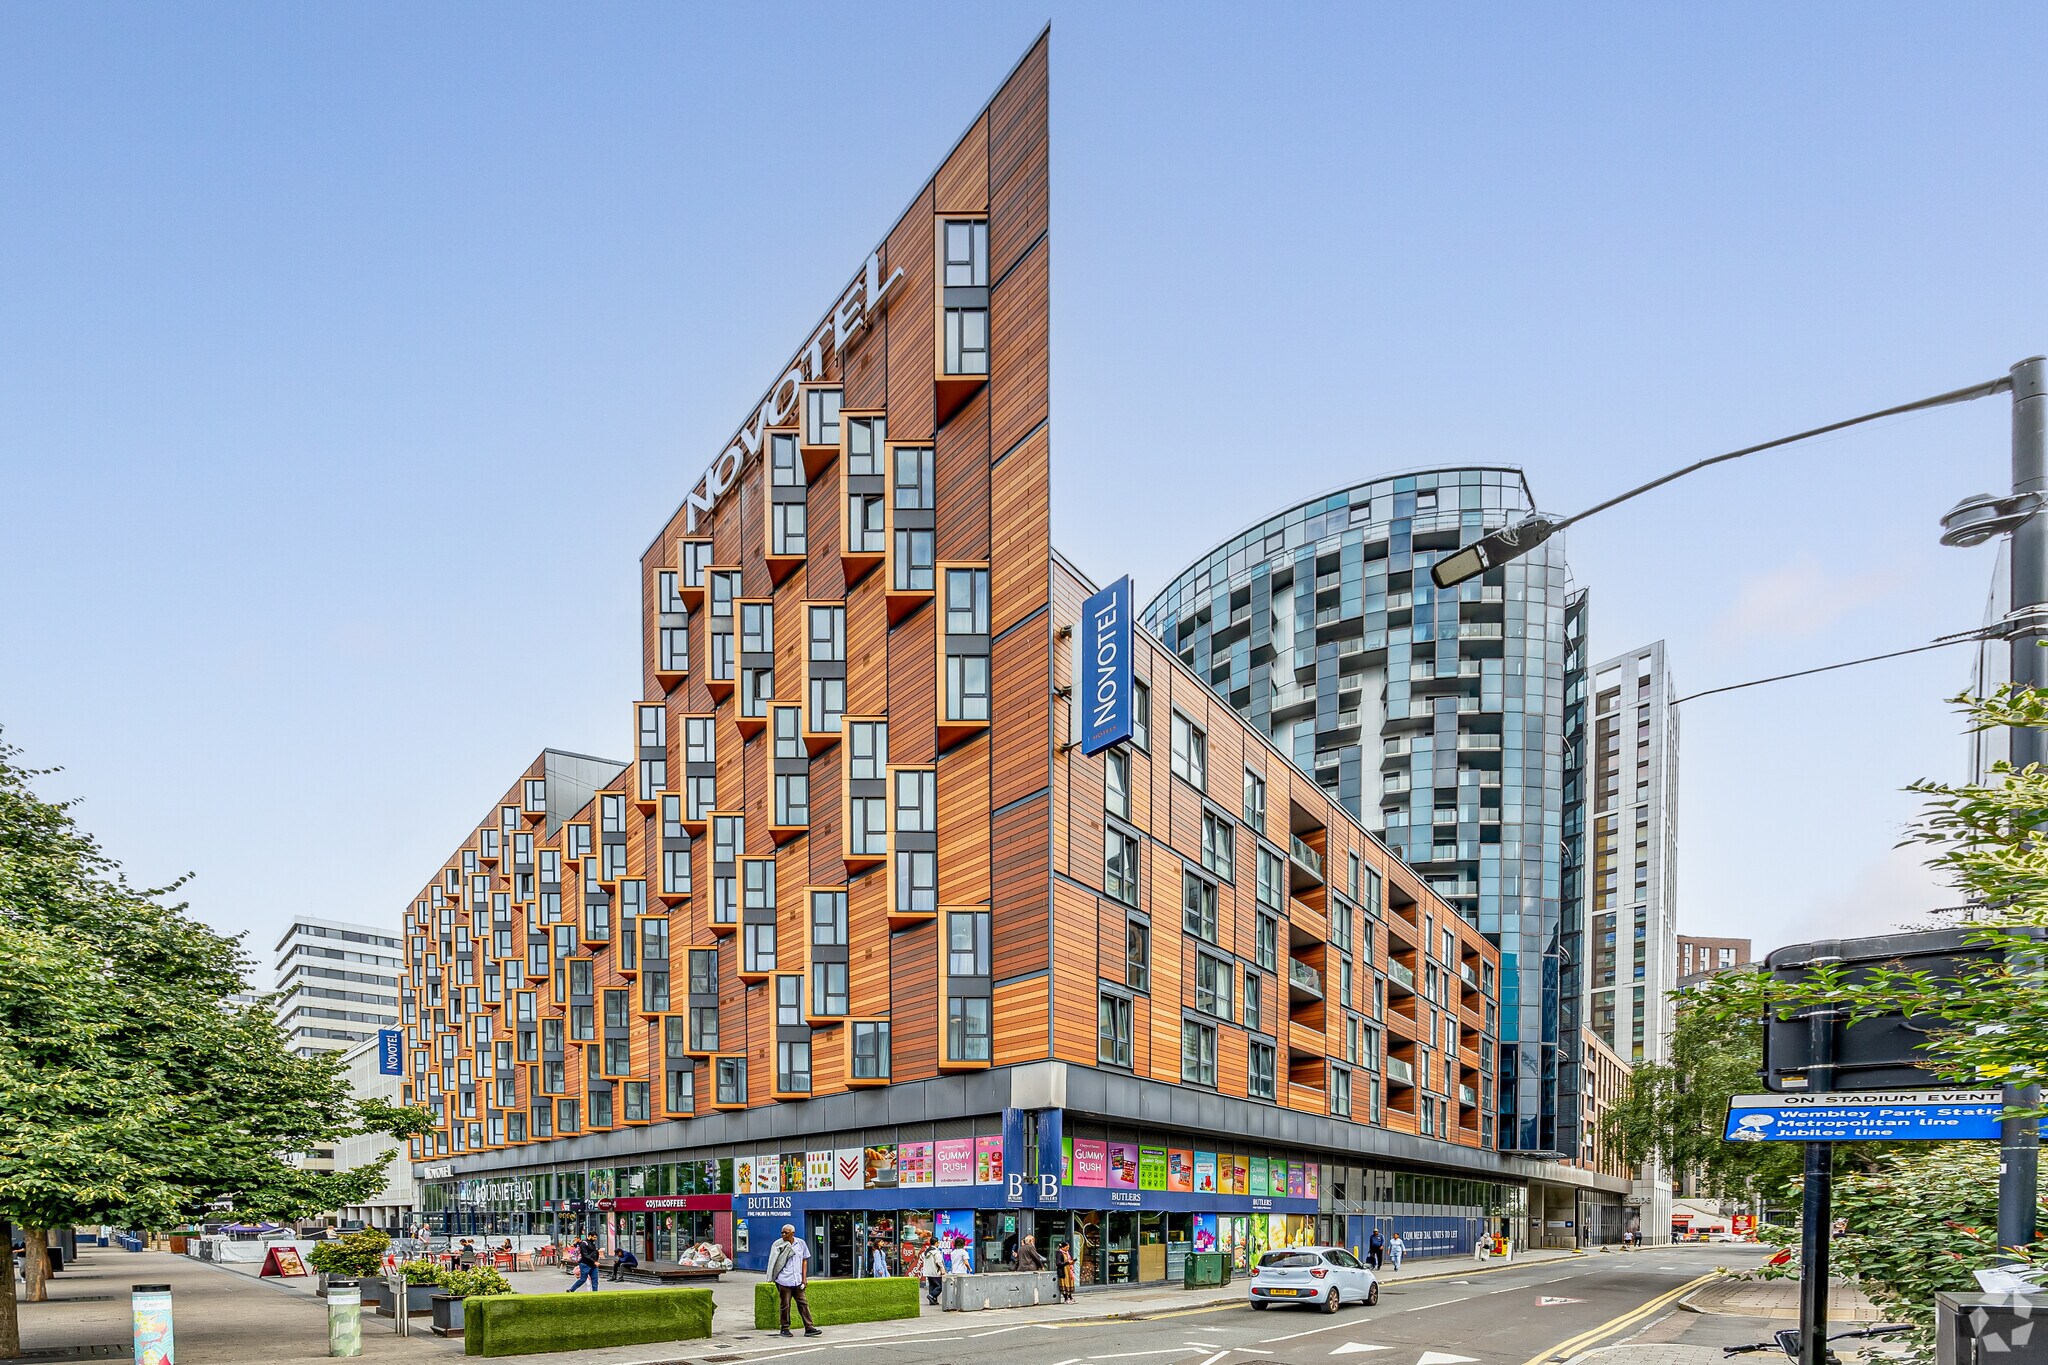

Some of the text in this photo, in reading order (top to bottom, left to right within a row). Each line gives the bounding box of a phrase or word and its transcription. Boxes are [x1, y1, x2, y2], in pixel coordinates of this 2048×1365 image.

[686, 252, 904, 533] NOVOTEL
[1093, 591, 1118, 729] NOVOTEL
[385, 1033, 398, 1070] NOVOTEL
[1784, 1093, 2000, 1104] ON STADIUM EVENT
[1780, 1108, 2003, 1118] Wembley Park Statio
[1776, 1119, 1910, 1127] Metropolitan
[1775, 1129, 1846, 1137] Jubilee
[937, 1151, 971, 1161] GUMMY
[1074, 1148, 1105, 1161] GUMMY
[942, 1162, 967, 1174] RUSH
[1079, 1161, 1102, 1173] RUSH
[1007, 1173, 1023, 1197] B
[1039, 1174, 1058, 1197] B
[748, 1196, 792, 1209] BUTLERS
[1111, 1192, 1141, 1202] BUTLERS
[1252, 1198, 1272, 1206] BUTLERS
[645, 1199, 687, 1209] COSTA COFFEE
